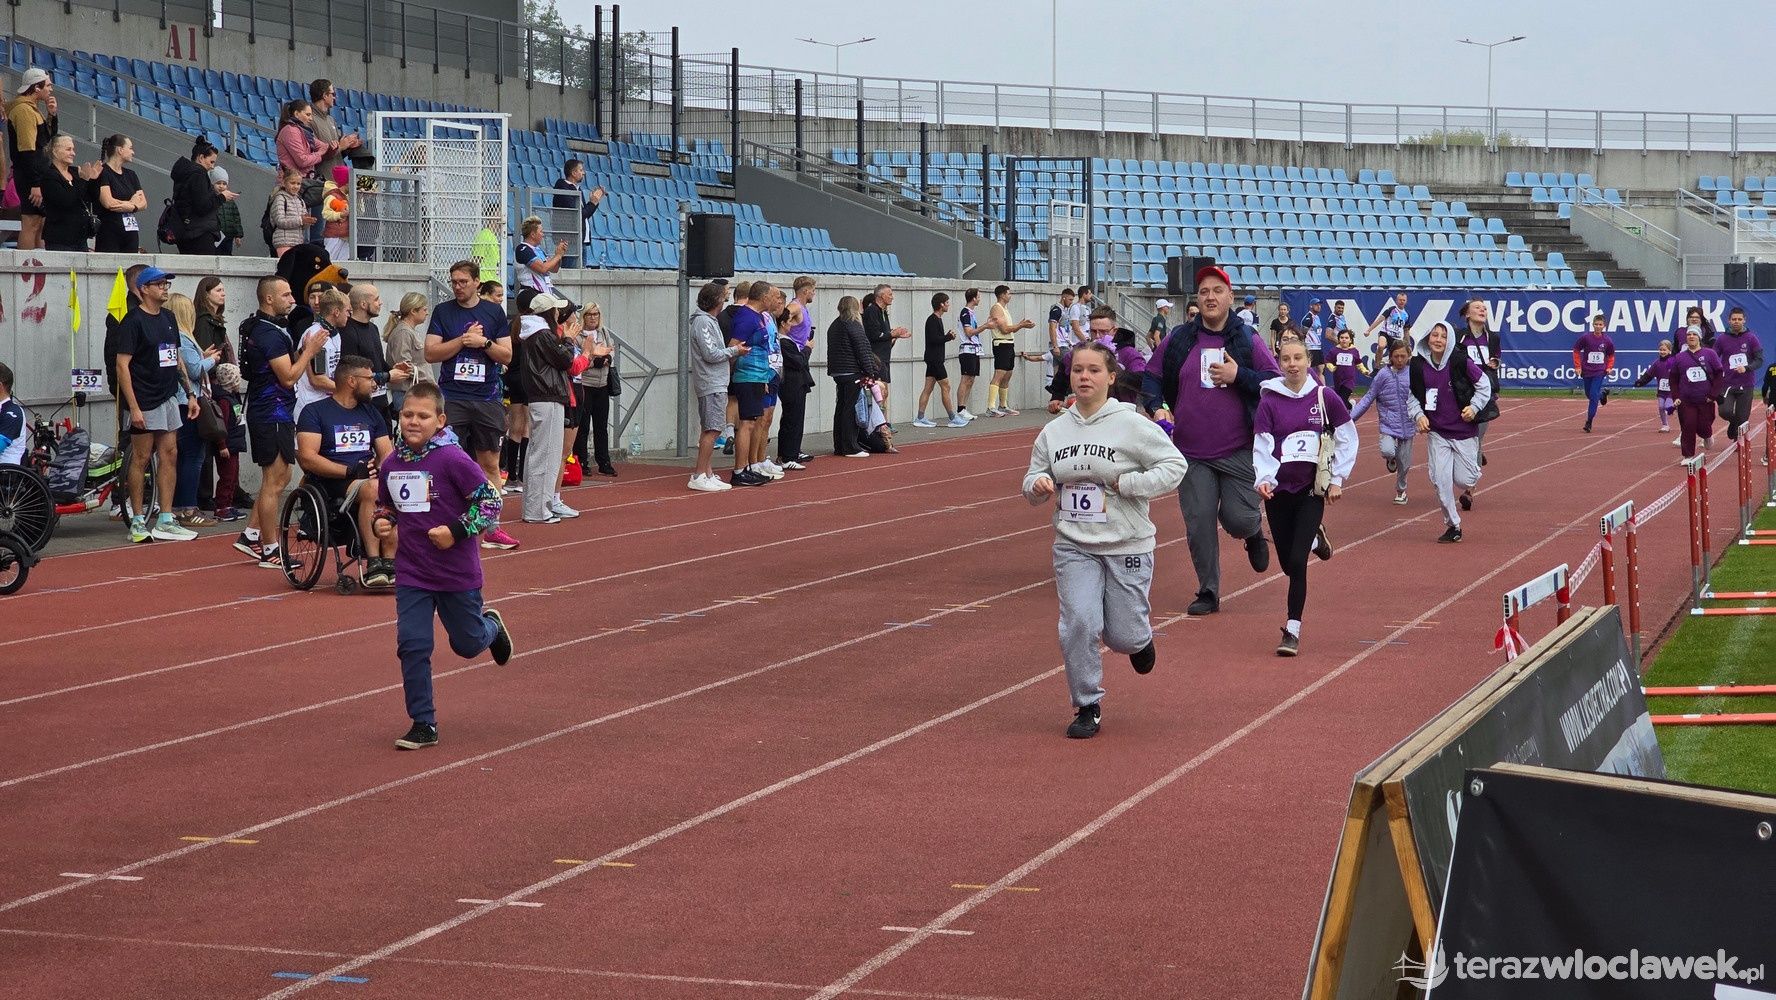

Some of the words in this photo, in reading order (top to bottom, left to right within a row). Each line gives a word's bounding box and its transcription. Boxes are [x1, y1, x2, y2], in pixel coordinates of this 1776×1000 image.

[459, 365, 481, 375] 651
[1496, 363, 1549, 380] iasto
[76, 375, 98, 386] 539
[340, 431, 366, 444] 652
[1296, 439, 1307, 453] 2
[1053, 444, 1081, 464] NEW
[1083, 443, 1116, 463] YORK
[399, 483, 411, 501] 6
[1071, 493, 1091, 511] 16
[1125, 557, 1141, 569] 88
